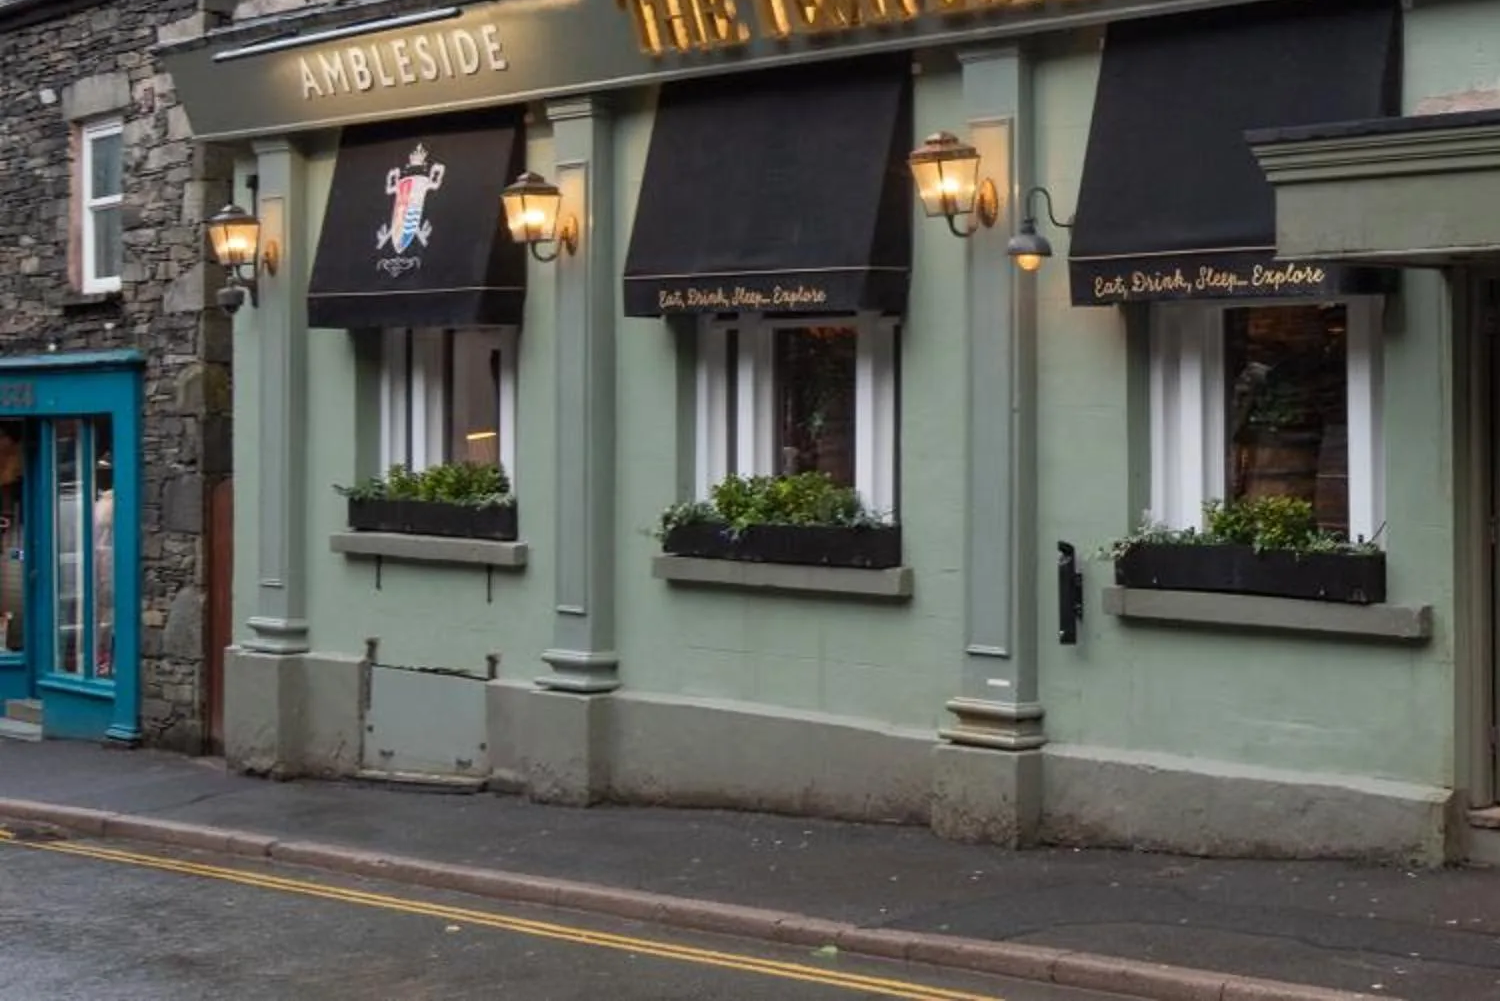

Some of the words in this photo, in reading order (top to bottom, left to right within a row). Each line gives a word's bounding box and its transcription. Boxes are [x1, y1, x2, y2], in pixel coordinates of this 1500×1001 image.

[300, 23, 508, 100] AMBLESIDE
[1094, 274, 1128, 298] Eat,
[1131, 268, 1192, 293] Drink,
[1252, 263, 1325, 289] Explore
